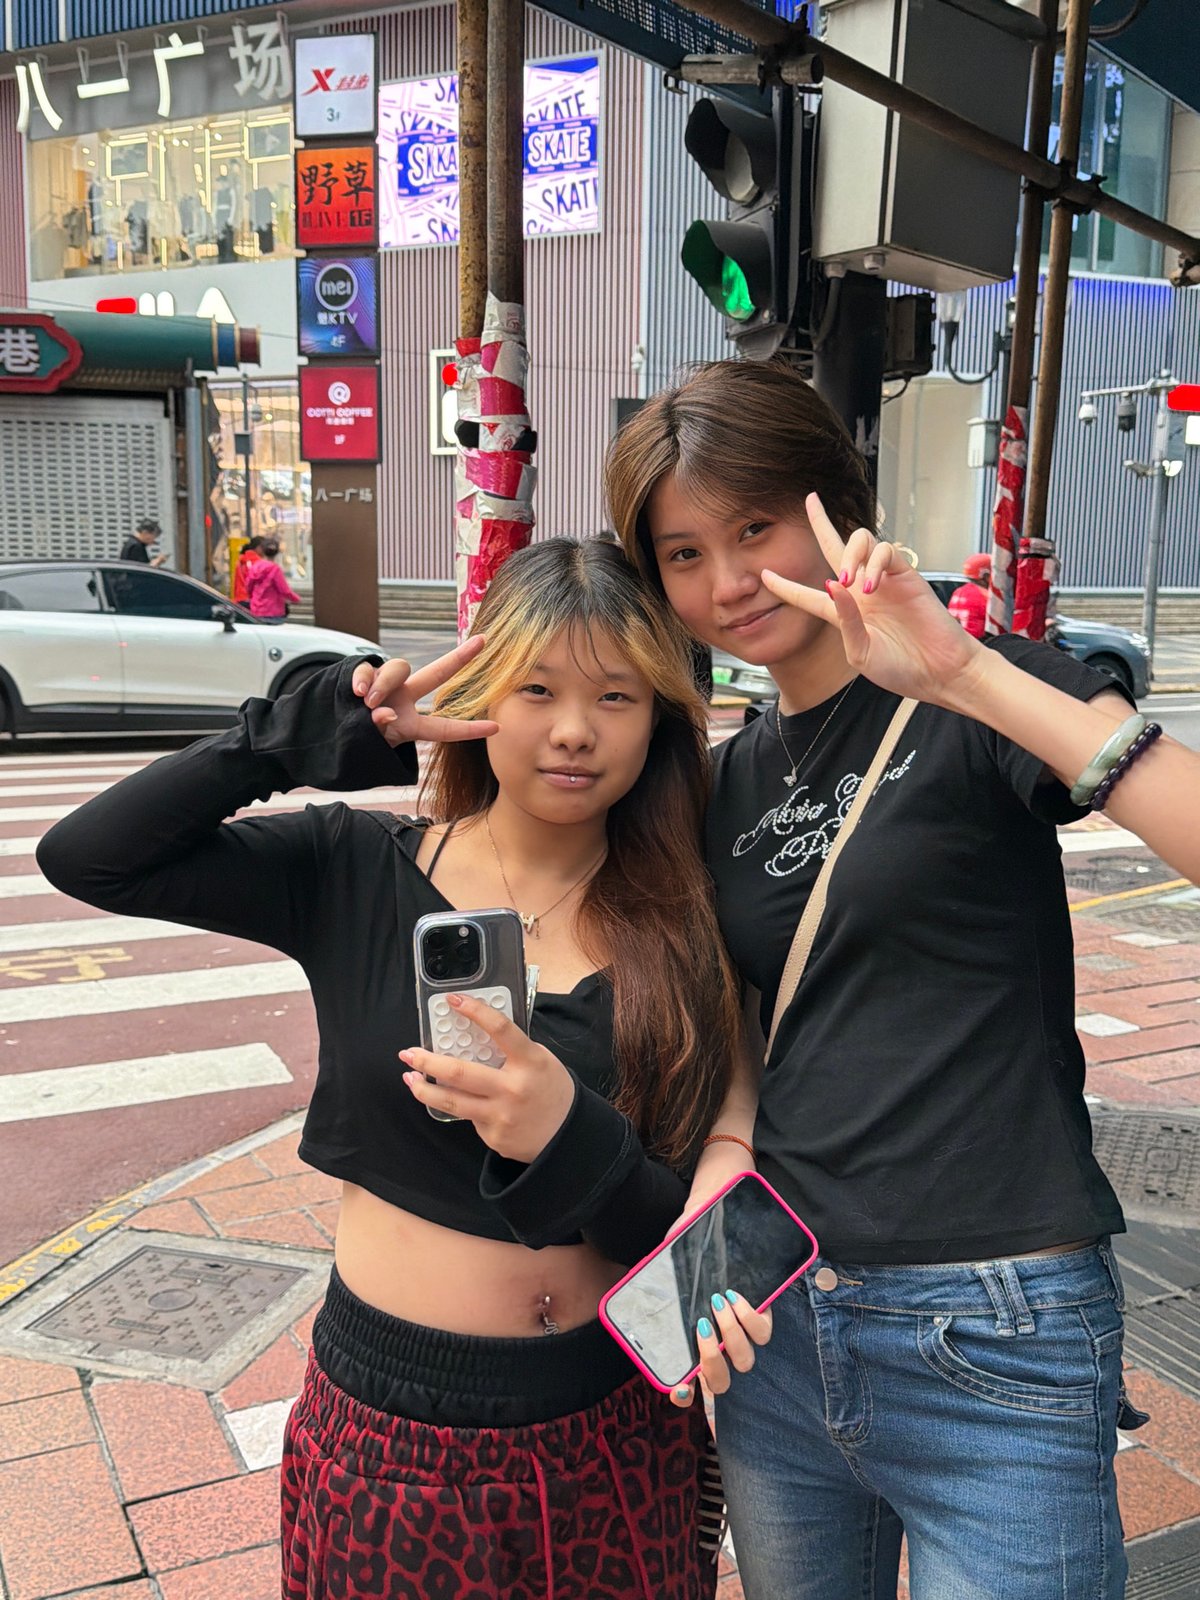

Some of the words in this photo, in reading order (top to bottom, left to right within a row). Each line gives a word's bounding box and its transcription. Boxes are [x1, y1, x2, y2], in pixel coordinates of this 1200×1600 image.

[16, 22, 292, 132] 八一广场
[532, 129, 588, 163] SKATE
[300, 160, 374, 206] 野草
[315, 488, 373, 502] 八一广场
